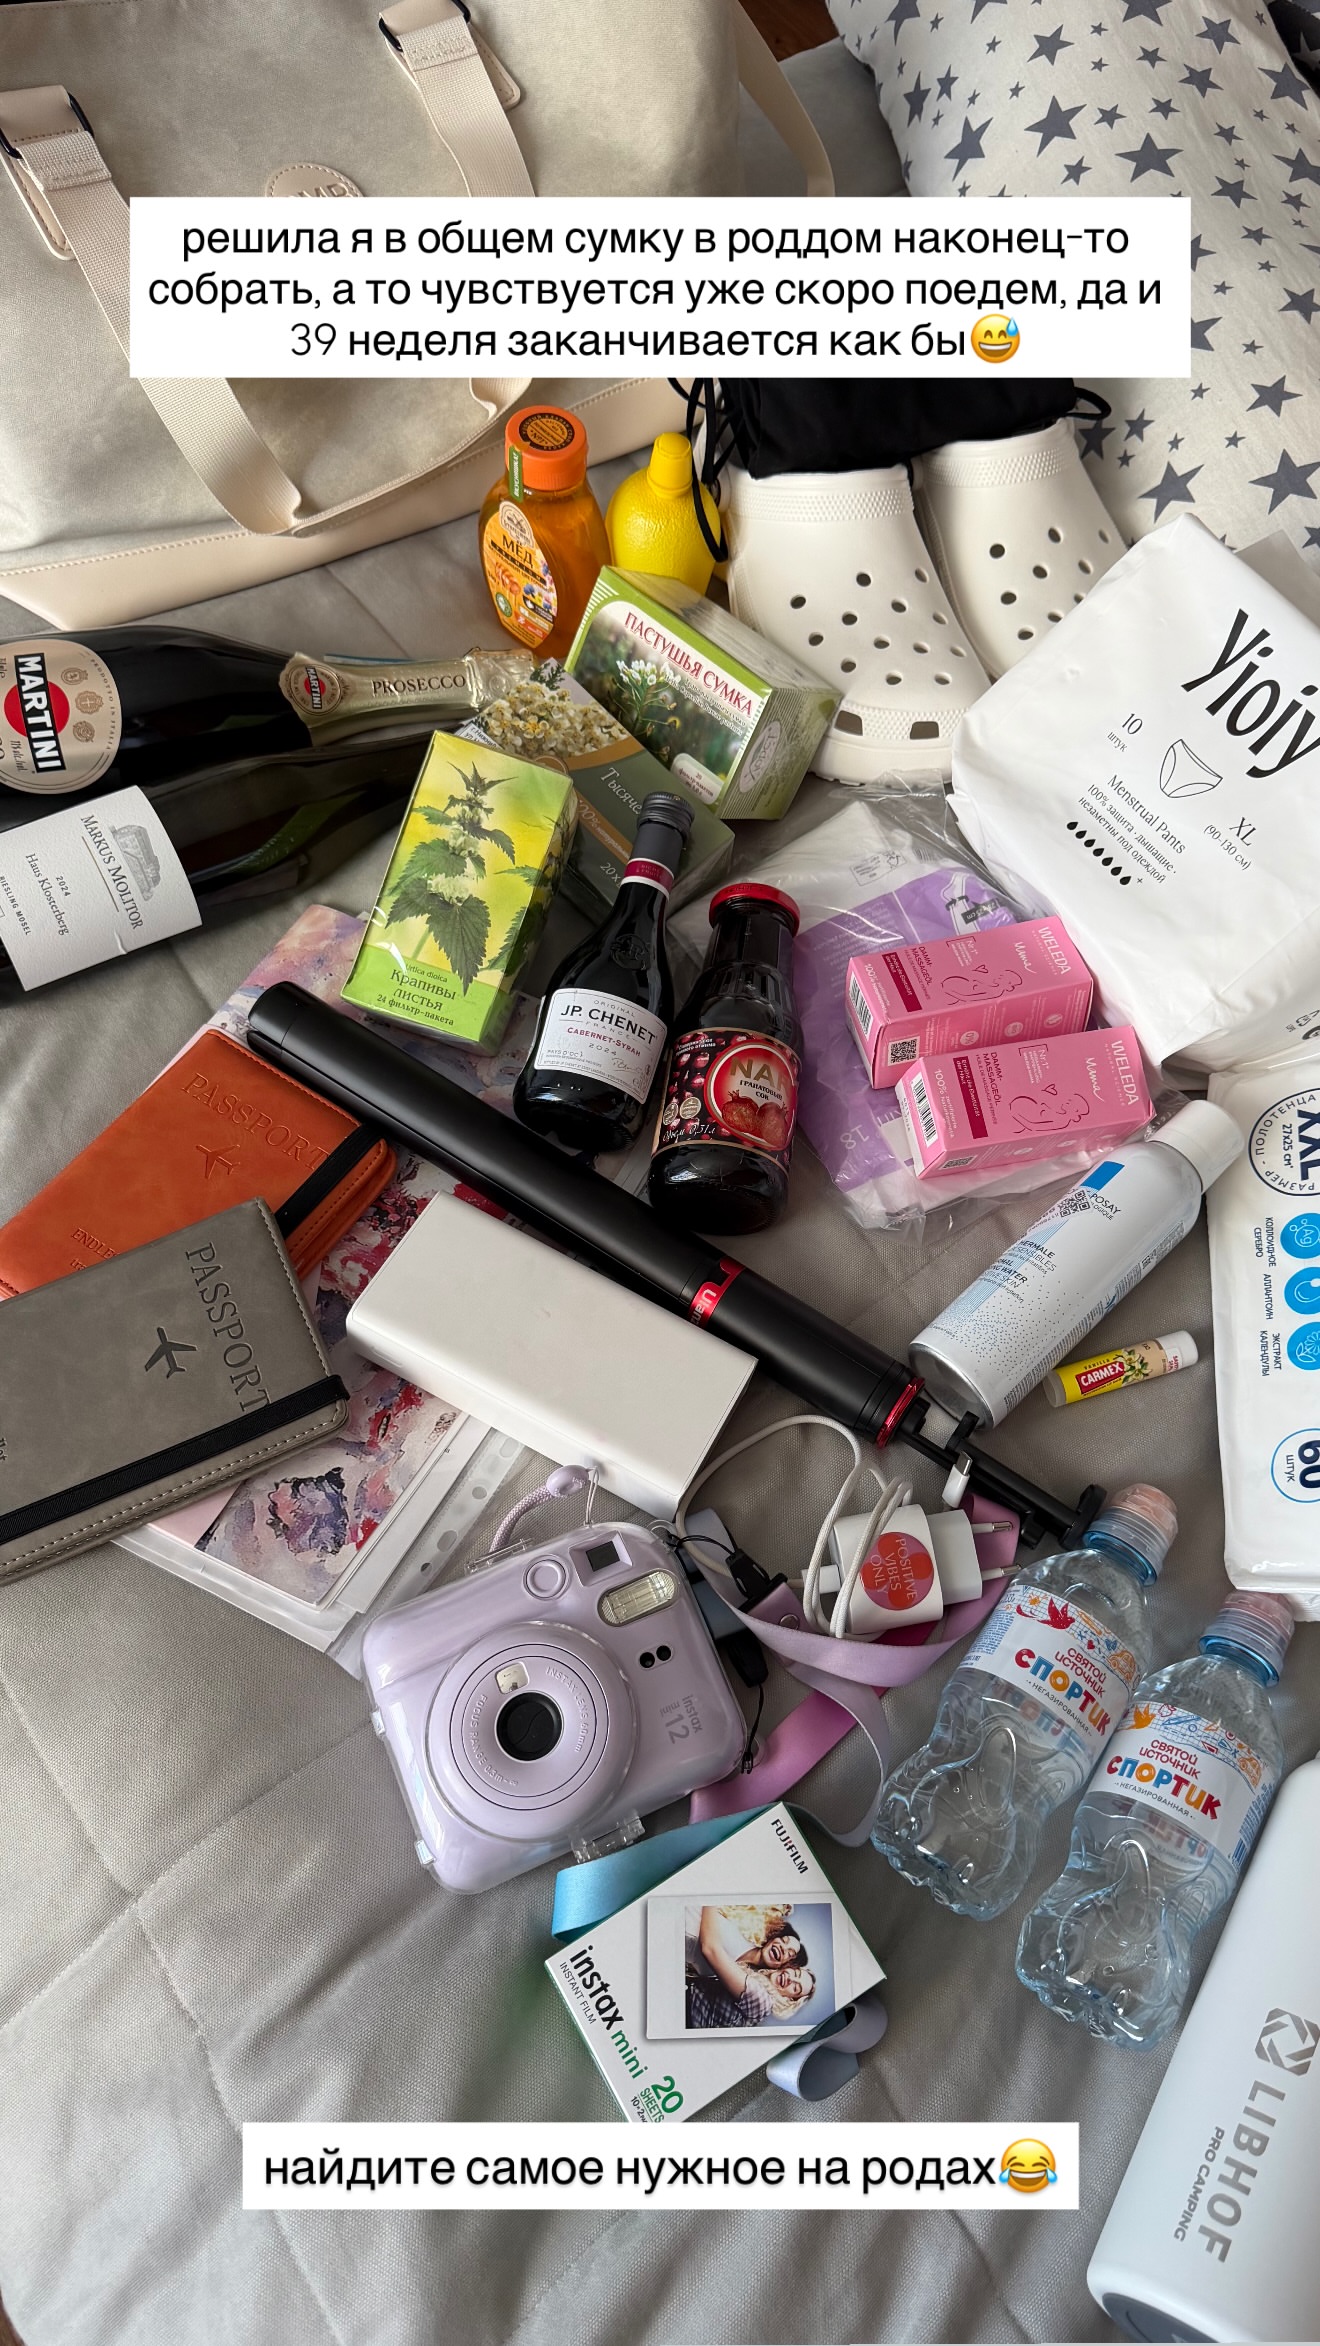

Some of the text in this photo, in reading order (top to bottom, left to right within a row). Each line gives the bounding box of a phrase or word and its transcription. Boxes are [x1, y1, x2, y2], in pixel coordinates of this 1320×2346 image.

[502, 534, 534, 568] МЁД
[91, 658, 114, 702] PRODOTTO
[372, 674, 466, 696] PROSECCO
[624, 611, 703, 680] ПАСТУШЬЯ
[703, 669, 754, 720] СУМКА
[306, 667, 322, 709] MARTINI
[17, 655, 62, 770] MARTINI
[1122, 713, 1143, 735] 10
[1107, 731, 1128, 753] штук
[600, 767, 643, 815] Тысяче
[1087, 784, 1175, 874] 100% защита дышащие
[1107, 774, 1187, 855] Menstrual Pants
[1229, 816, 1257, 847] XL
[1078, 796, 1168, 885] незаметны под одеждой
[1203, 824, 1252, 872] (90-130 см)
[55, 875, 72, 897] 2024
[80, 814, 144, 930] MARKUS MOLITOR
[25, 853, 70, 936] Haus Klosterberg
[15, 910, 32, 936] MOSEL
[911, 948, 933, 985] MASSAGEÖL
[918, 946, 933, 967] DAMM-
[1038, 926, 1072, 976] WELEDA
[390, 968, 457, 1000] Крапивы
[426, 971, 448, 983] dioica
[377, 994, 454, 1026] 24 фильтр-пакета
[393, 988, 443, 1011] листья
[594, 999, 636, 1018] ORIGINAL
[560, 1004, 583, 1017] JP.
[588, 1008, 655, 1045] CHENET
[567, 1027, 641, 1057] CABERNET-SYRAH
[585, 1021, 631, 1039] FRANCE
[588, 1042, 617, 1056] 2024
[990, 1052, 1003, 1081] DAMM-
[934, 1069, 947, 1095] 100%
[982, 1053, 1001, 1106] MASSAGEÖL
[1085, 1057, 1105, 1102] Mama
[1110, 1039, 1140, 1106] WELEDA
[755, 1091, 769, 1101] СОК
[180, 1072, 332, 1171] PASSPORT
[839, 1125, 870, 1150] 18
[1282, 1123, 1293, 1150] 27x25
[1255, 1093, 1317, 1191] РАЗМЕР ПОЛОТЕНЦА
[71, 1227, 120, 1260] ENDLE
[1253, 1227, 1263, 1258] СЕРЕБРО
[1265, 1216, 1277, 1267] КОЛЛОИДНОЕ
[1300, 1228, 1313, 1245] Ag
[1003, 1267, 1028, 1284] WATER
[1263, 1273, 1273, 1320] АЛЛАНТОИН
[185, 1241, 271, 1412] PASSPORT
[1084, 1358, 1110, 1370] VANILLA
[1260, 1330, 1270, 1377] КАЛЕНДУЛЫ
[1272, 1333, 1282, 1371] ЭКСТРАКТ
[1080, 1364, 1123, 1387] CARMEX
[1298, 1440, 1320, 1489] 60
[870, 1554, 889, 1594] ONLY
[884, 1552, 902, 1591] VIBES
[895, 1538, 918, 1600] POSITIVE
[1054, 1650, 1107, 1699] ИСТОЧНИК
[1067, 1647, 1107, 1685] СВЯТОЙ
[573, 1694, 589, 1723] LENS
[659, 1701, 681, 1718] mini
[1014, 1648, 1111, 1737] СПОРТИК
[1031, 1682, 1089, 1734] НЕГАЗИРОВАННАЯ
[469, 1693, 488, 1766] FOCUS RANGE
[665, 1713, 690, 1745] 12
[682, 1694, 703, 1733] instax
[1138, 1747, 1201, 1781] ИСТОЧНИК
[1150, 1738, 1199, 1767] СВЯТОЙ
[1106, 1755, 1222, 1820] СПОРТИК
[1119, 1782, 1190, 1817] НЕГАЗИРОВАННАЯ
[771, 1818, 809, 1874] FUJIFILM
[559, 1961, 597, 2025] INSTANT FILM
[569, 1944, 649, 2080] instax mini
[640, 2087, 665, 2122] SHEETS
[650, 2075, 684, 2114] 20
[1173, 2126, 1225, 2243] PRO CAMPING
[1198, 2079, 1286, 2264] LIBHOF
